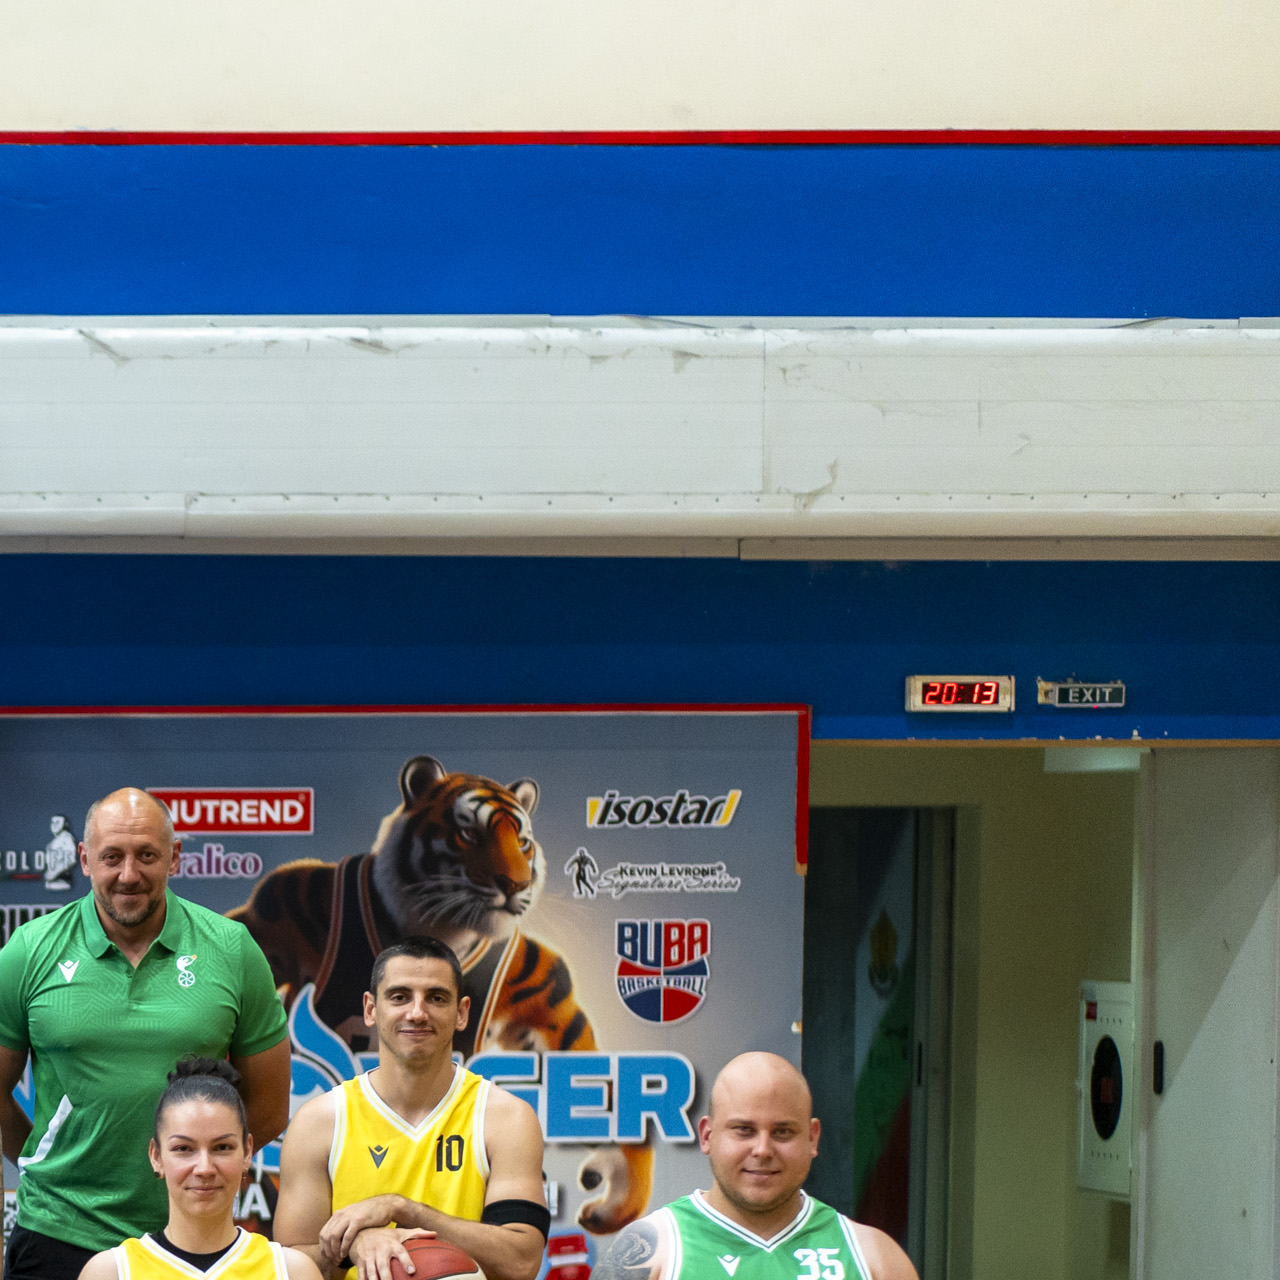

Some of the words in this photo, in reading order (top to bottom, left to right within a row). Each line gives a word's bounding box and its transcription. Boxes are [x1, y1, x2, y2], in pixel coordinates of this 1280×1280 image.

[924, 682, 997, 705] 20:13
[1068, 688, 1113, 703] EXIT
[597, 790, 734, 826] isostar
[687, 874, 740, 891] Series
[617, 921, 709, 968] BUBA
[618, 975, 707, 998] BASKETBALL
[435, 1134, 465, 1172] 10
